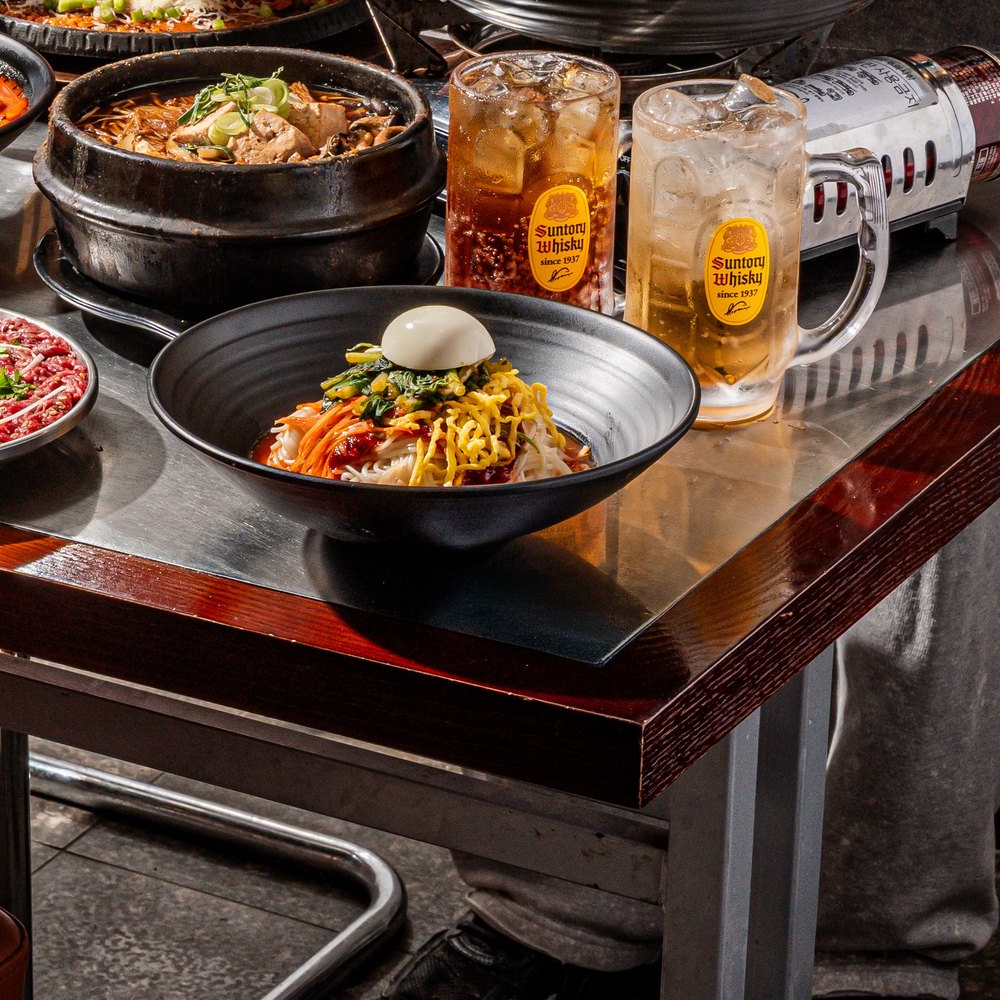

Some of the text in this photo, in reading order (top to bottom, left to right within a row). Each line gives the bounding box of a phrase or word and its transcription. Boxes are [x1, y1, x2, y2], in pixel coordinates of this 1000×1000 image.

[534, 222, 586, 238] Suntory
[536, 237, 584, 255] Whisky
[540, 255, 580, 266] since 1937
[711, 256, 765, 270] Suntory
[713, 270, 763, 288] Whisky
[717, 289, 758, 298] since 1937
